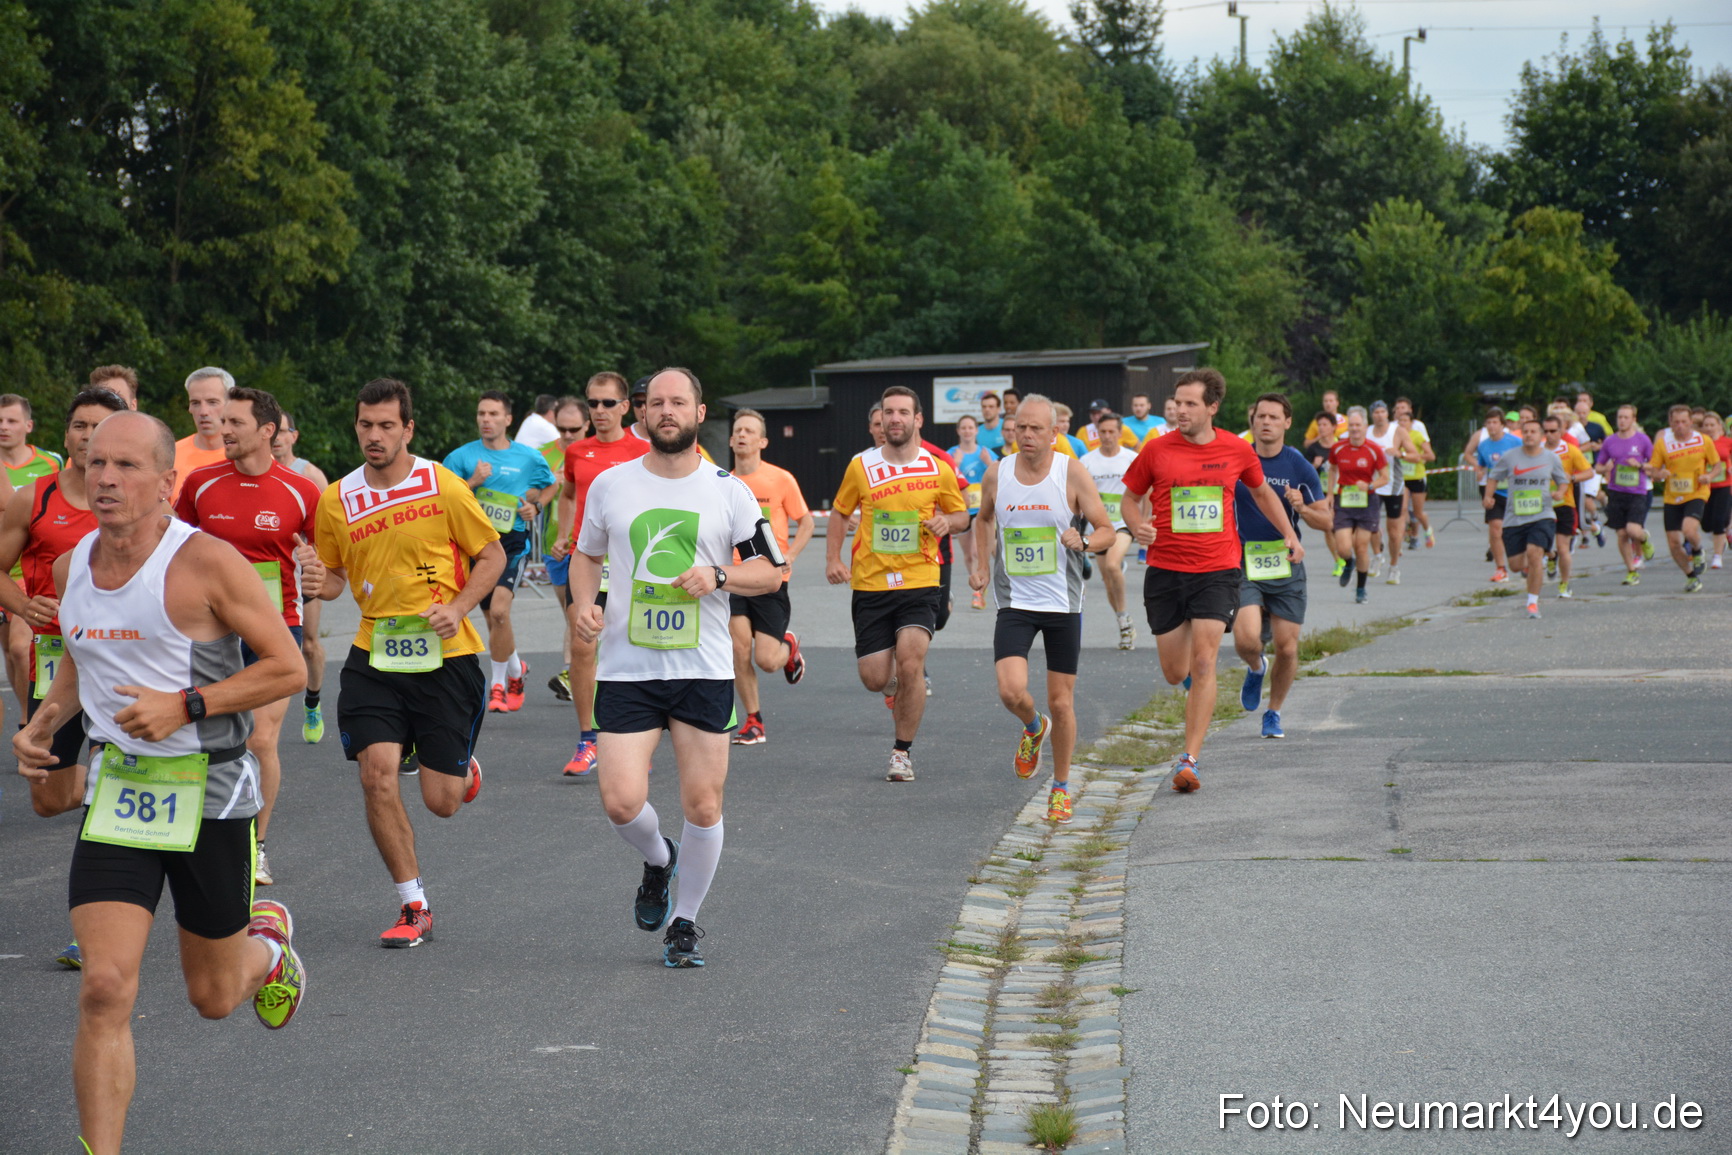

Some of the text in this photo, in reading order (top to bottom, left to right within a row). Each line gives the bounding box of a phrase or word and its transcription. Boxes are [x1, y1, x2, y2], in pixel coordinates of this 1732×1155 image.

[870, 479, 940, 503] MAX BÖGL
[1177, 504, 1218, 519] 1479
[349, 503, 444, 545] MAX BÖGL
[881, 528, 911, 542] 902
[1015, 546, 1045, 563] 591
[1254, 555, 1281, 569] 353
[643, 608, 685, 631] 100
[86, 628, 146, 640] KLEBL
[384, 637, 429, 657] 883
[114, 787, 177, 824] 581
[114, 825, 170, 837] Berthold Schmid
